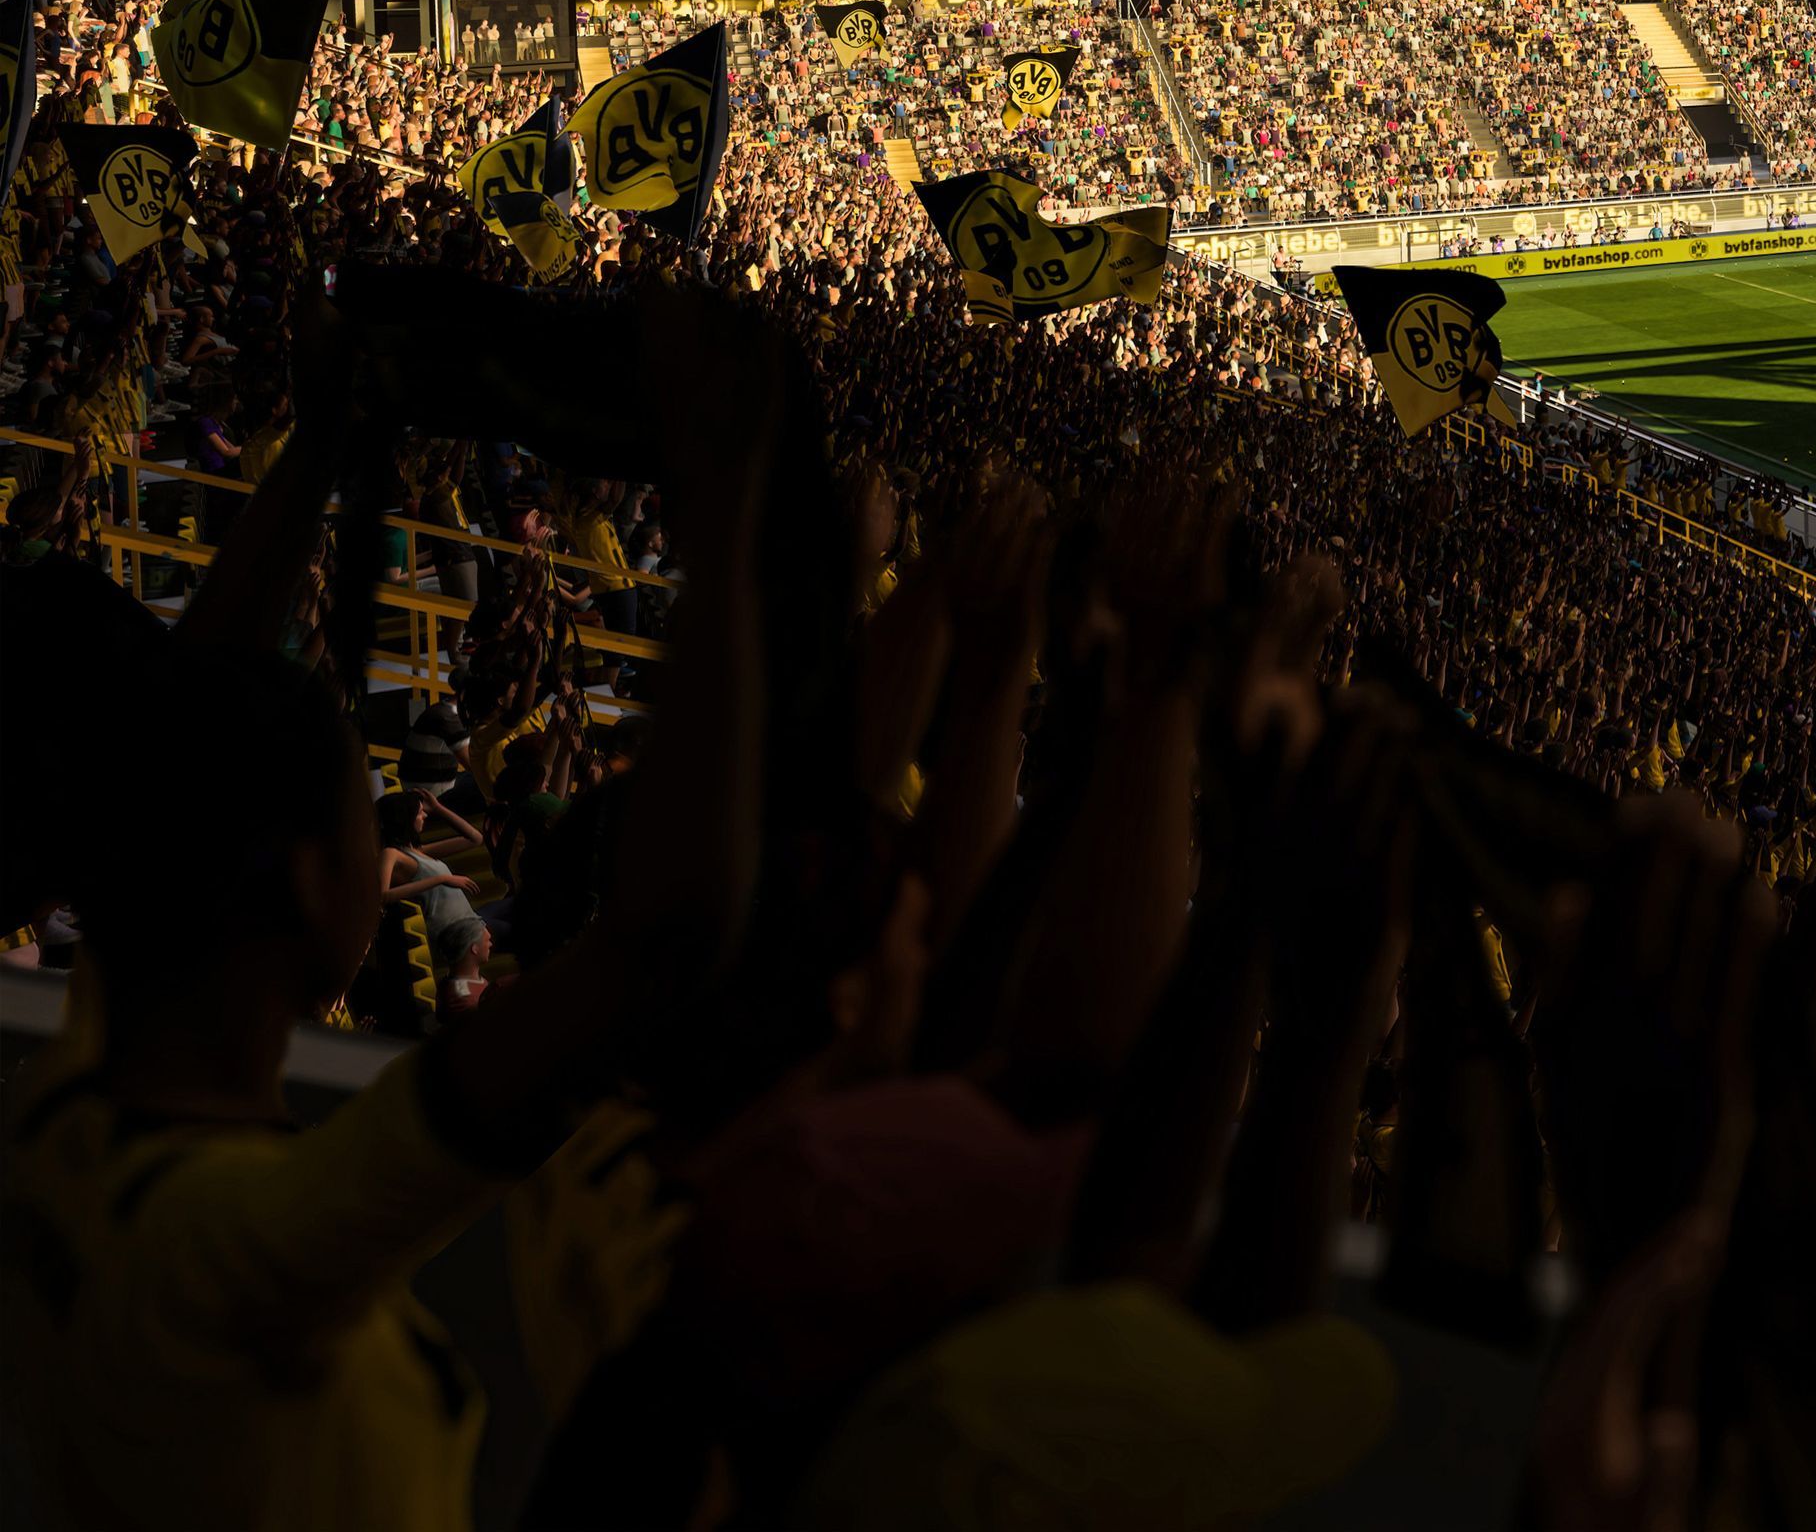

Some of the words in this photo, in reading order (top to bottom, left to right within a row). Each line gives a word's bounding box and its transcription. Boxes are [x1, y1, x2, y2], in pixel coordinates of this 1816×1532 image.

[114, 154, 170, 207] BVB
[1023, 259, 1069, 291] 09
[1543, 247, 1664, 270] bvbfanshop.com
[1404, 305, 1472, 369] BVB
